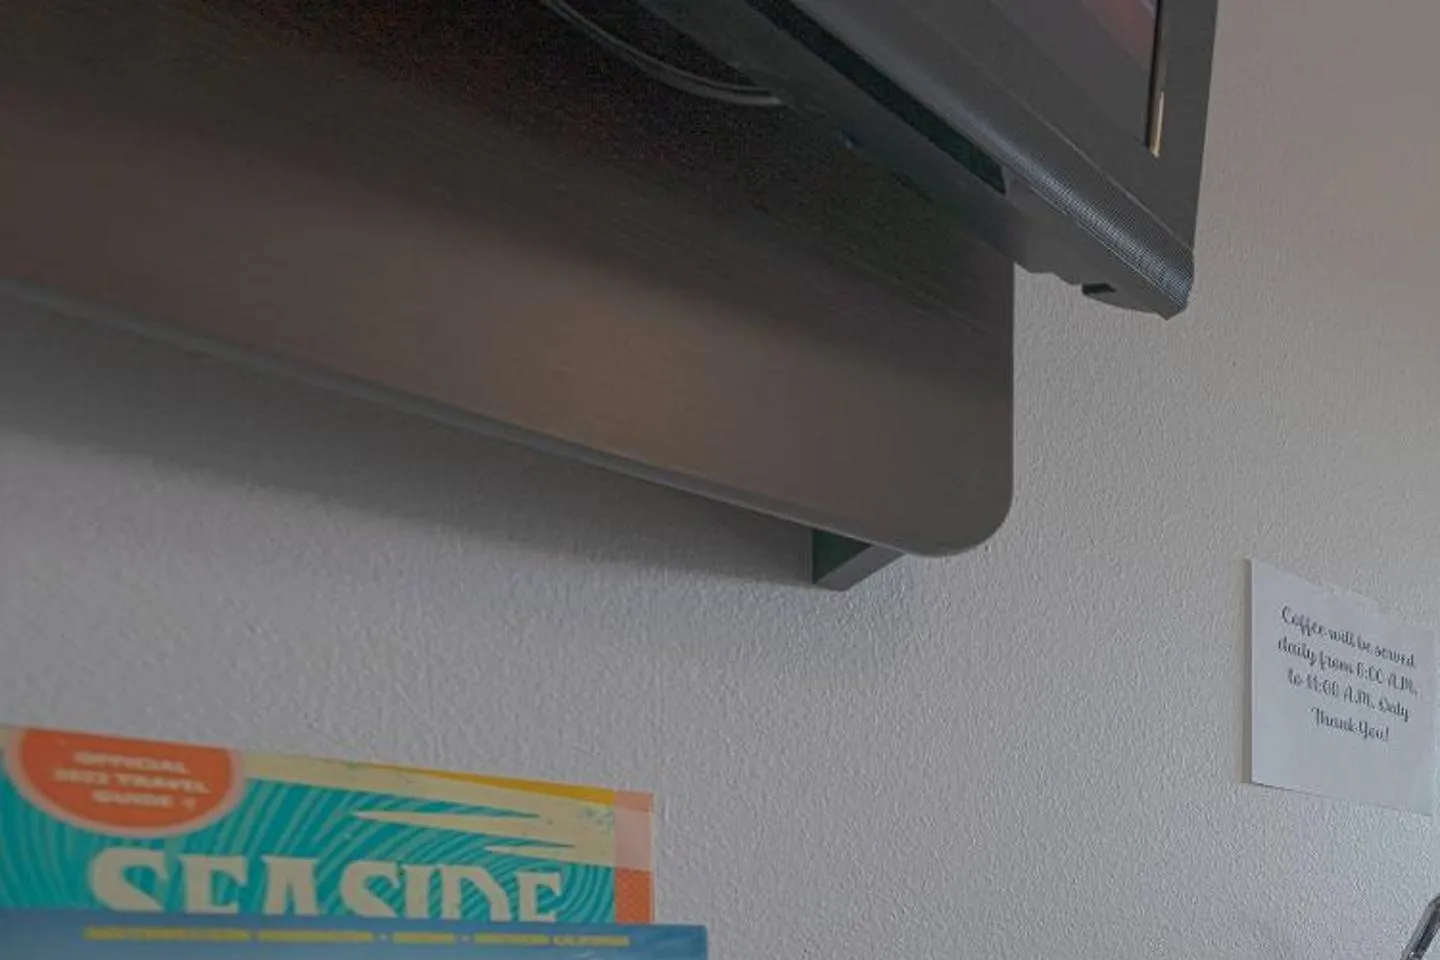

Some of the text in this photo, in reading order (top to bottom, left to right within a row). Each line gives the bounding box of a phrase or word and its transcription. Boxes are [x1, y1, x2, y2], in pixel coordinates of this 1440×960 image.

[1277, 636, 1318, 667] daily
[1319, 650, 1354, 675] from
[1281, 605, 1416, 668] Coffee will be served
[1287, 667, 1302, 687] to
[1378, 696, 1410, 723] Only
[1310, 705, 1356, 733] Thank
[87, 848, 563, 925] SEASIDE
